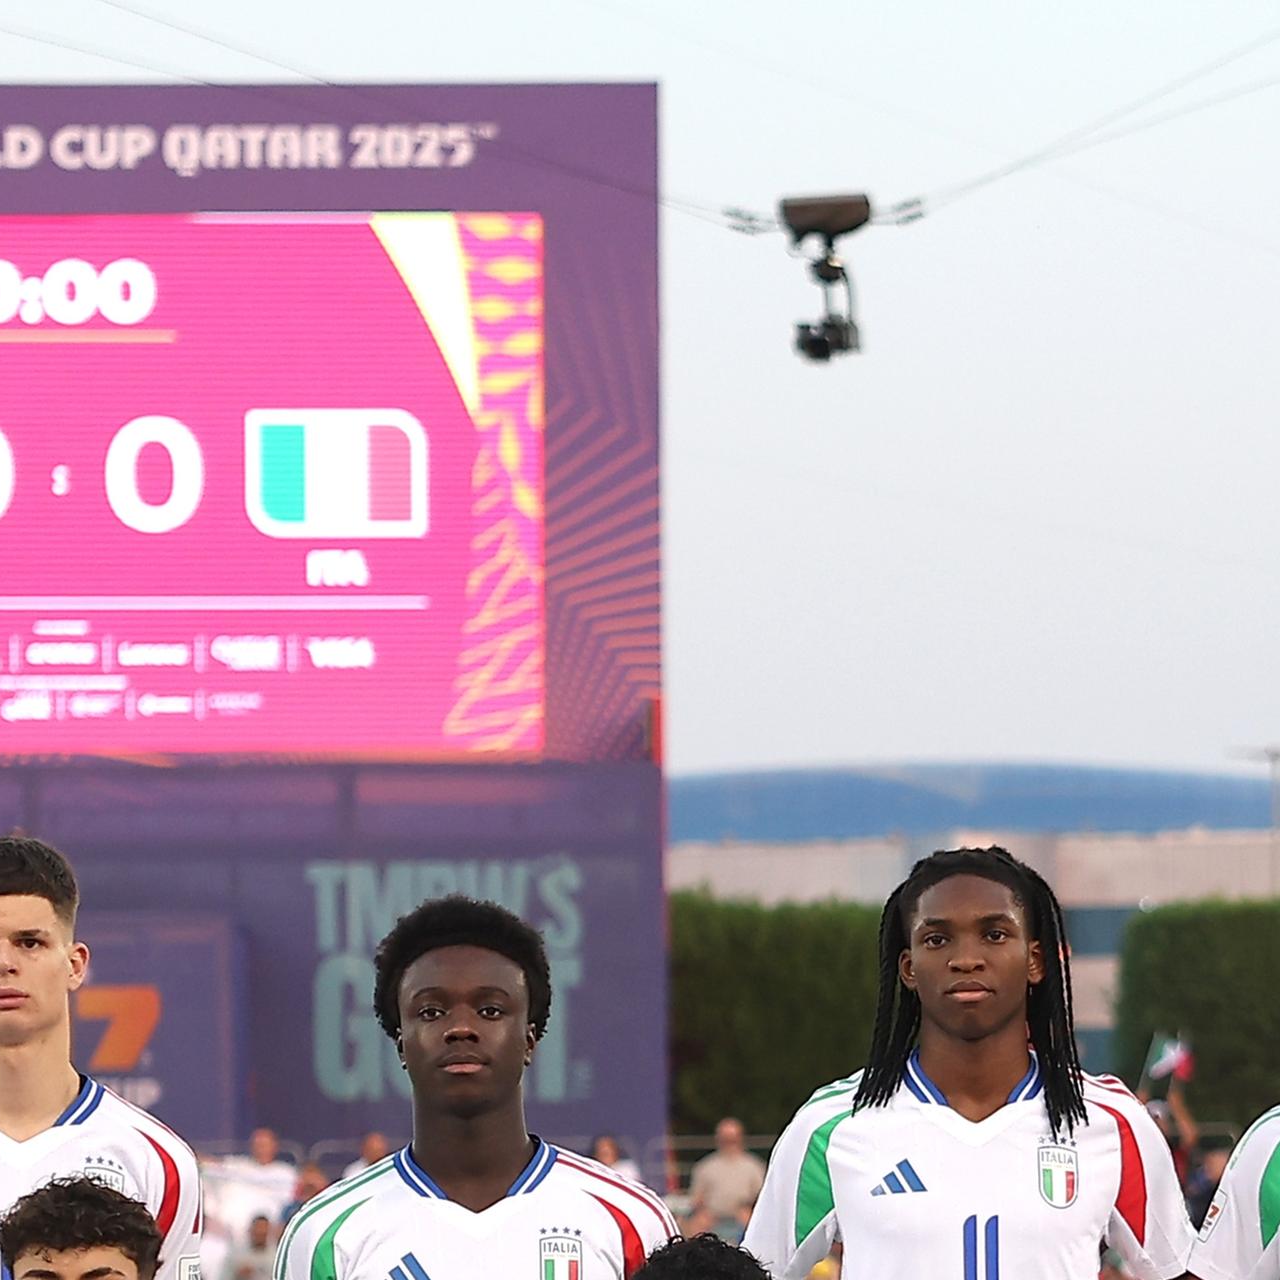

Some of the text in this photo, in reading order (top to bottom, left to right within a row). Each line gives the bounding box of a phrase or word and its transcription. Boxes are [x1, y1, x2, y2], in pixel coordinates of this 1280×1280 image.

[50, 124, 156, 170] CUP
[162, 124, 343, 177] QATAR
[349, 123, 477, 169] 2025
[105, 414, 205, 534] 0
[313, 953, 582, 1102] GT
[1040, 1151, 1074, 1165] ITALIA
[543, 1242, 579, 1254] ITALIA
